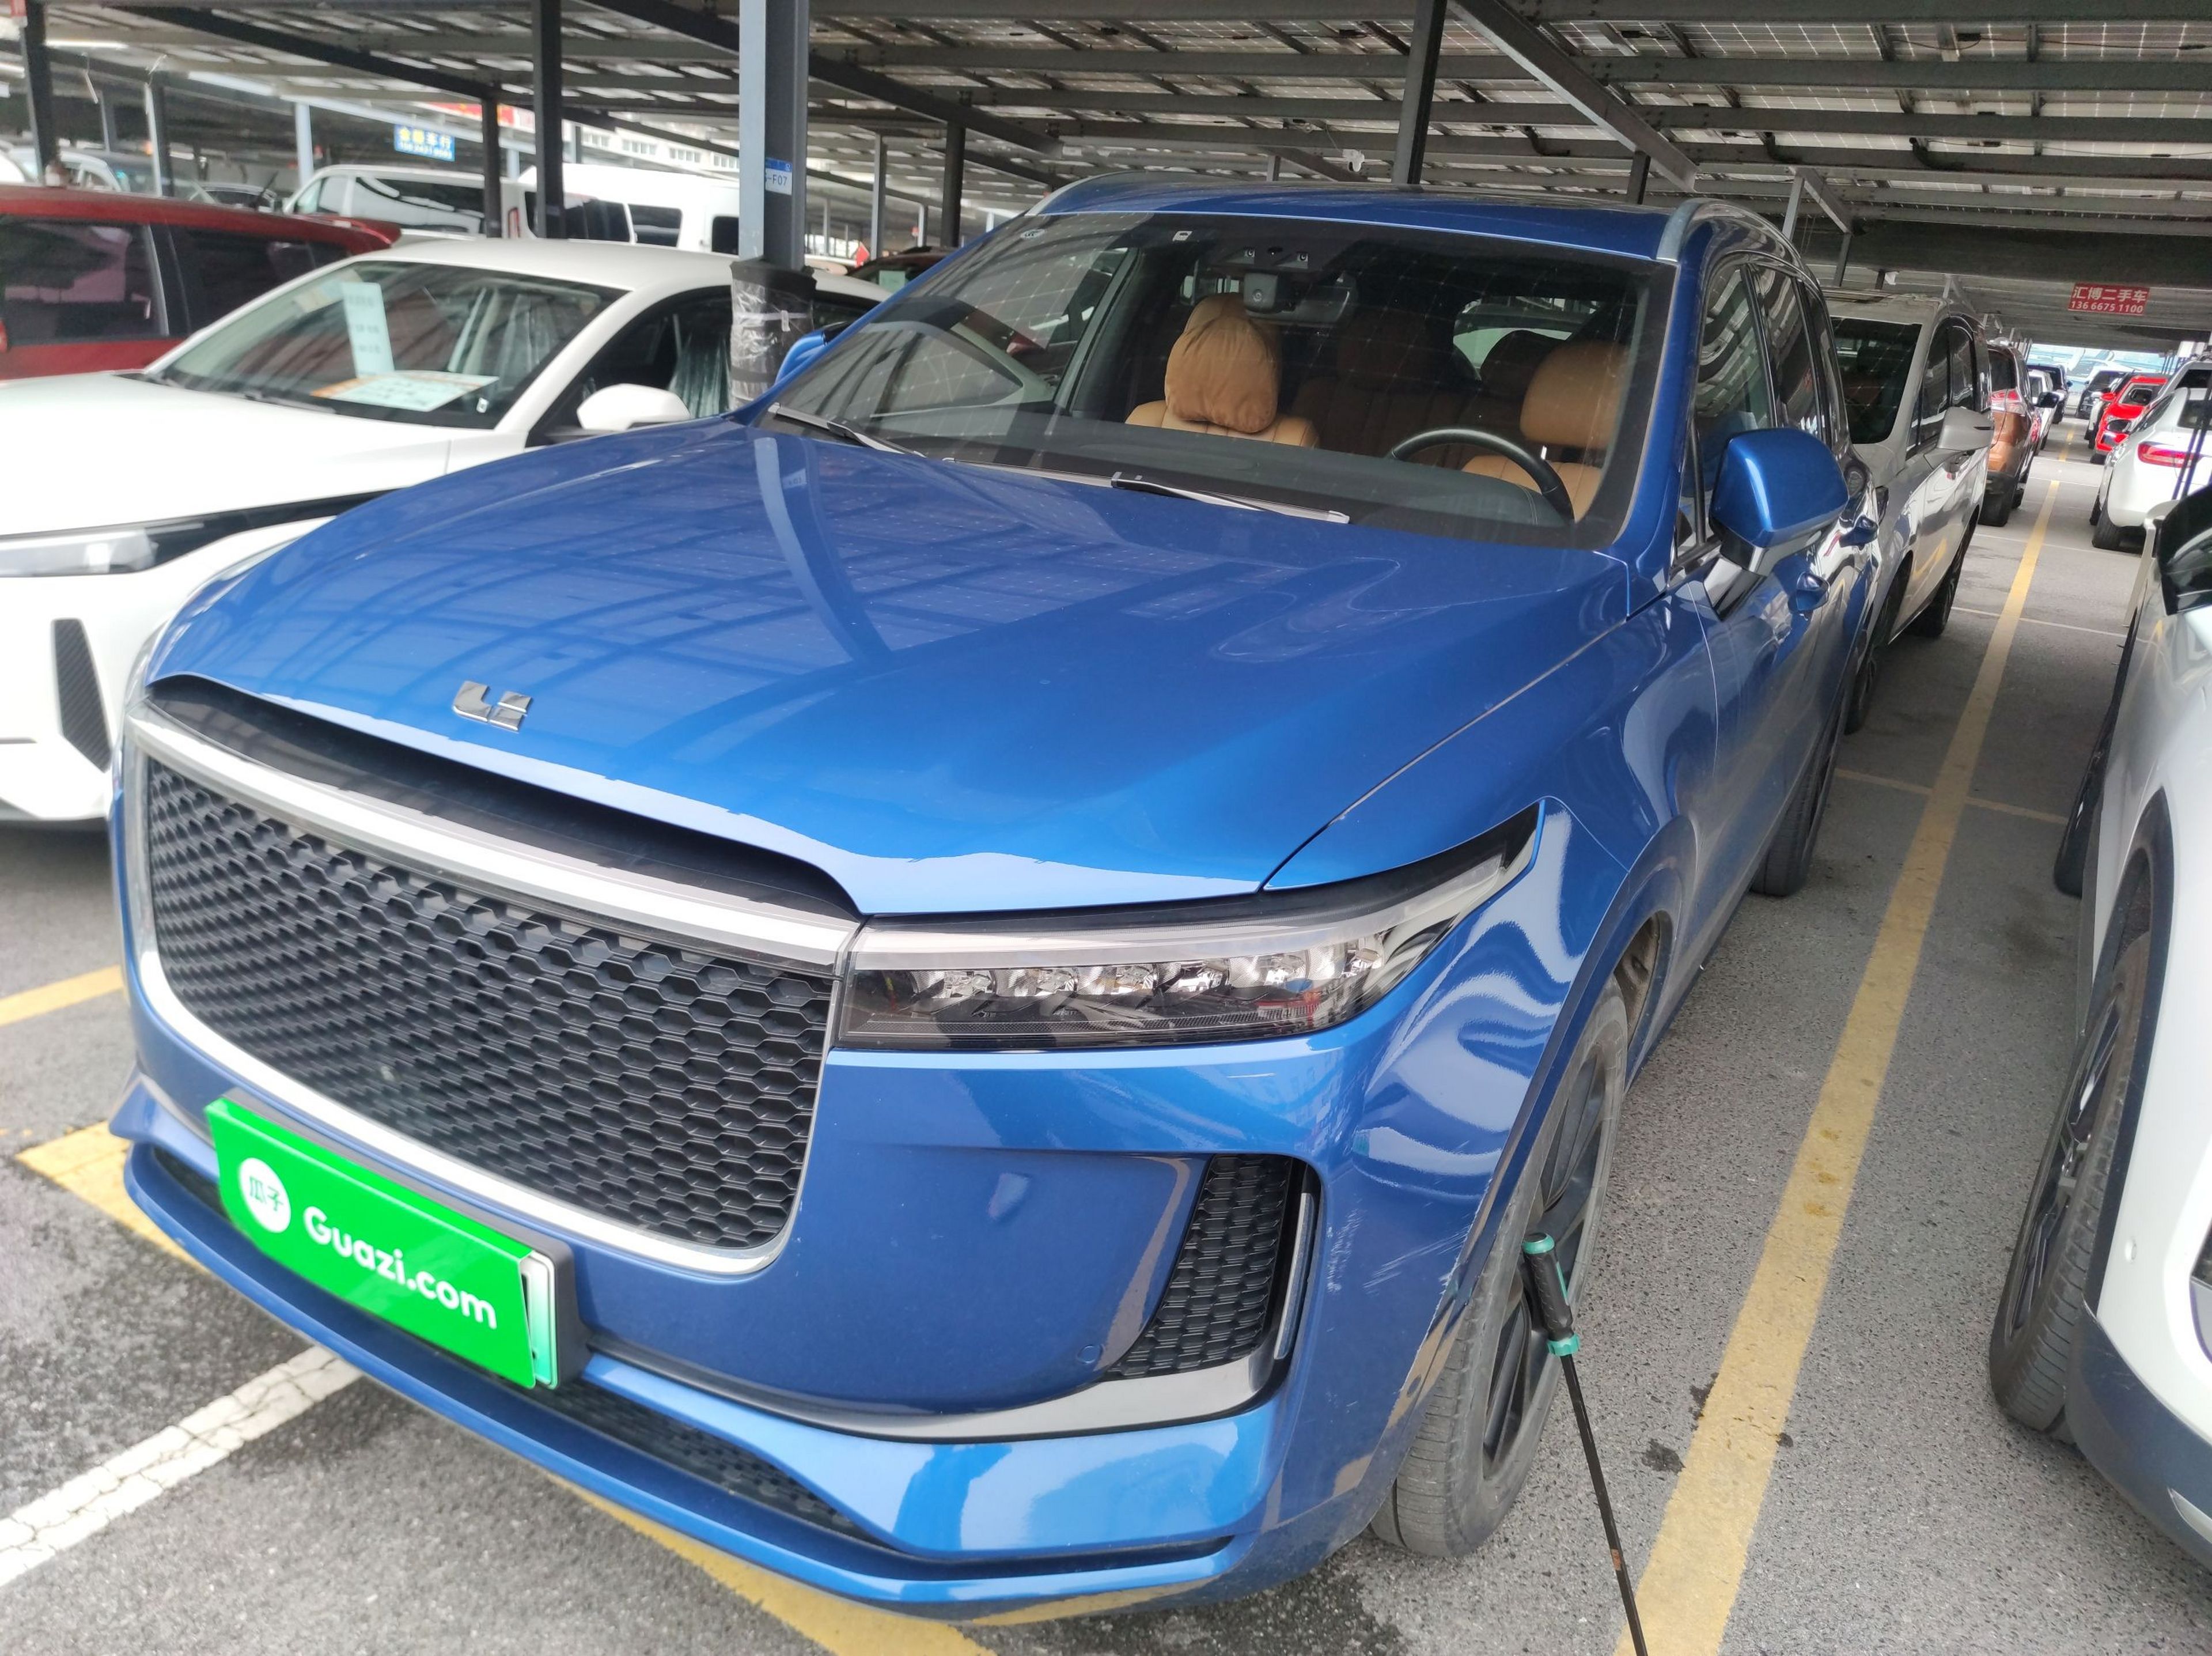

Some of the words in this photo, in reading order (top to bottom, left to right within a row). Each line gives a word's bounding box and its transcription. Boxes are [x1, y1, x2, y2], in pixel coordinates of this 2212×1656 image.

[764, 174, 788, 186] -F07
[2072, 286, 2148, 303] 汇博二手车
[2071, 301, 2089, 309] 136
[2090, 303, 2116, 311] 6675
[2119, 304, 2143, 313] 1100
[249, 1175, 284, 1211] 瓜子
[303, 1206, 497, 1329] Guazi.com
